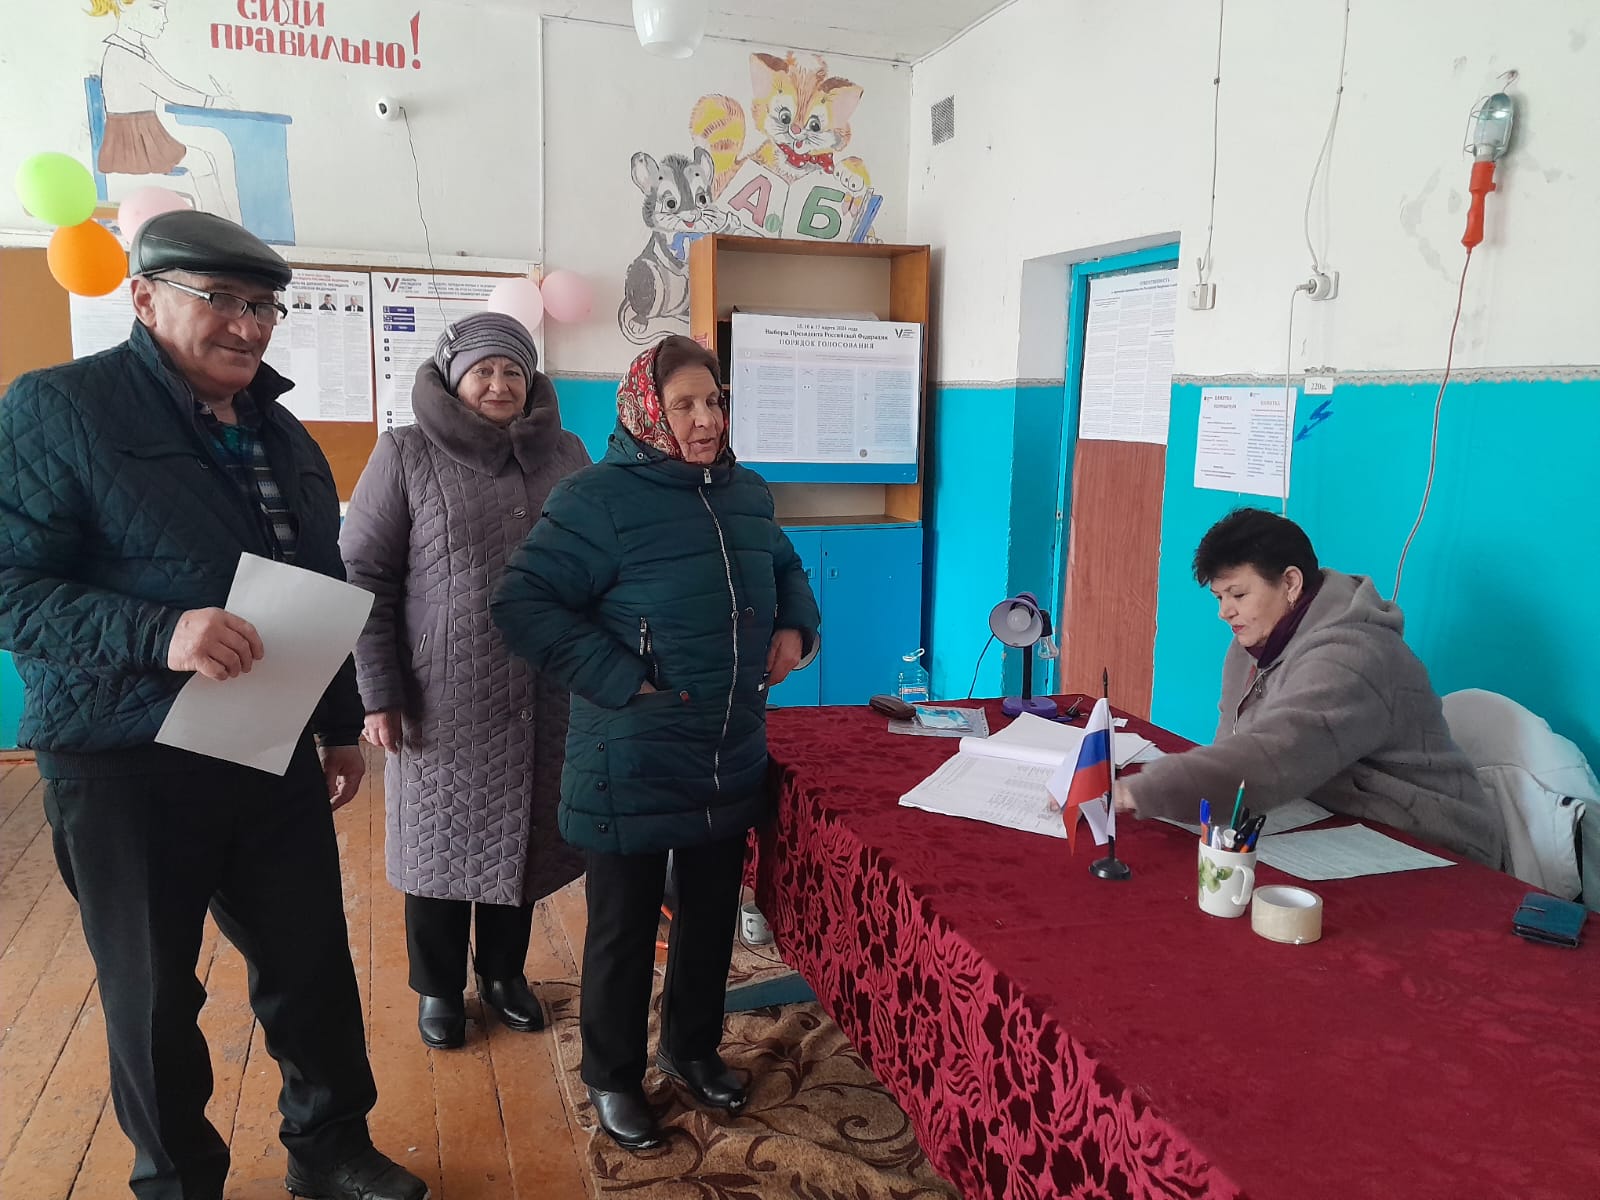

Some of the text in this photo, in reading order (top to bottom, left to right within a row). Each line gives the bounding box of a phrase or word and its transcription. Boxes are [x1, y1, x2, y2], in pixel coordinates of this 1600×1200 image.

[728, 174, 772, 228] А
[797, 185, 845, 239] Б
[765, 328, 789, 337] Выборы
[790, 330, 823, 338] Президента
[818, 341, 874, 349] ГОЛОСОВАНИЯ
